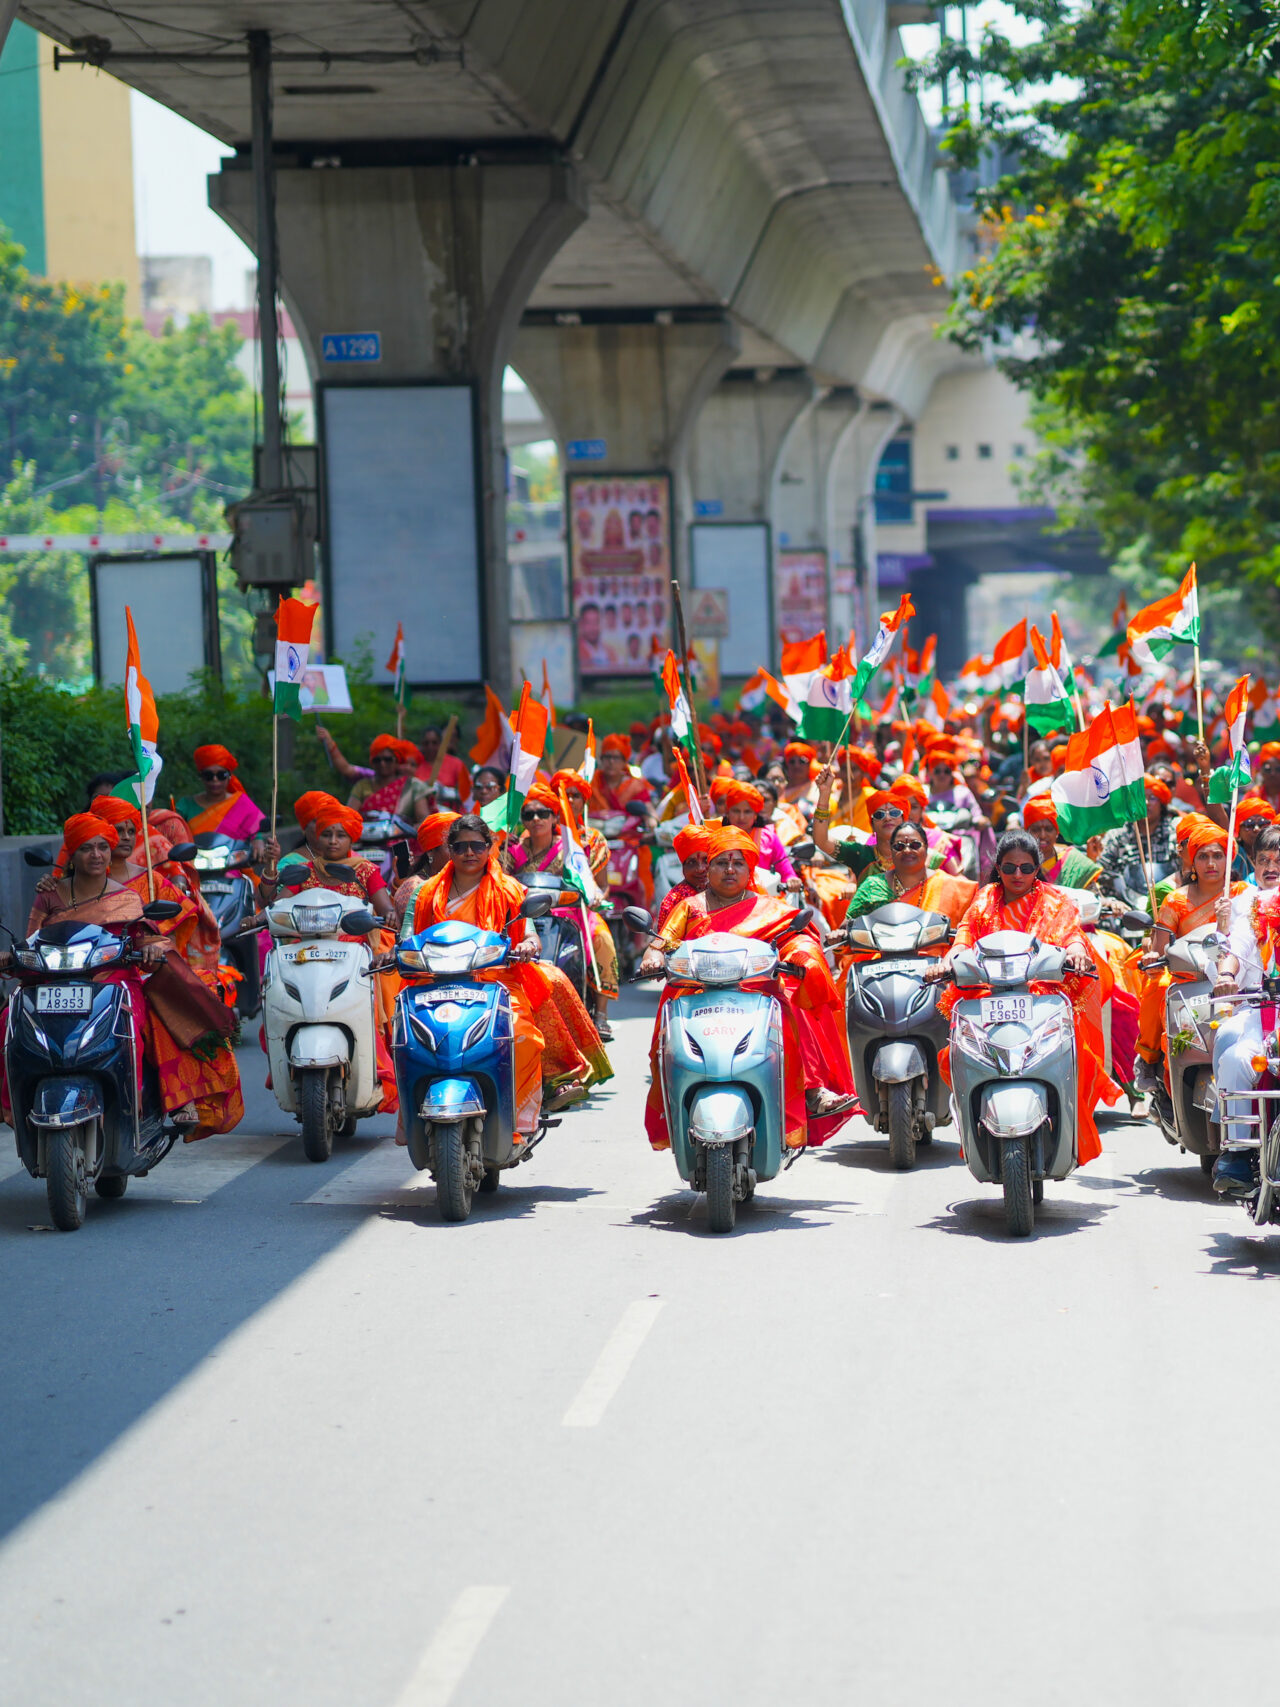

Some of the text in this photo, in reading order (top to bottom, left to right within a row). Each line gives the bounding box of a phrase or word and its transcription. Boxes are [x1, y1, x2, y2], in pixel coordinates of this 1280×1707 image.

[326, 338, 376, 357] A 1299
[47, 988, 84, 998] TG 11
[47, 999, 84, 1009] A8353
[990, 998, 1026, 1010] TG 10
[694, 1007, 713, 1017] AP09
[990, 1009, 1026, 1021] E3650
